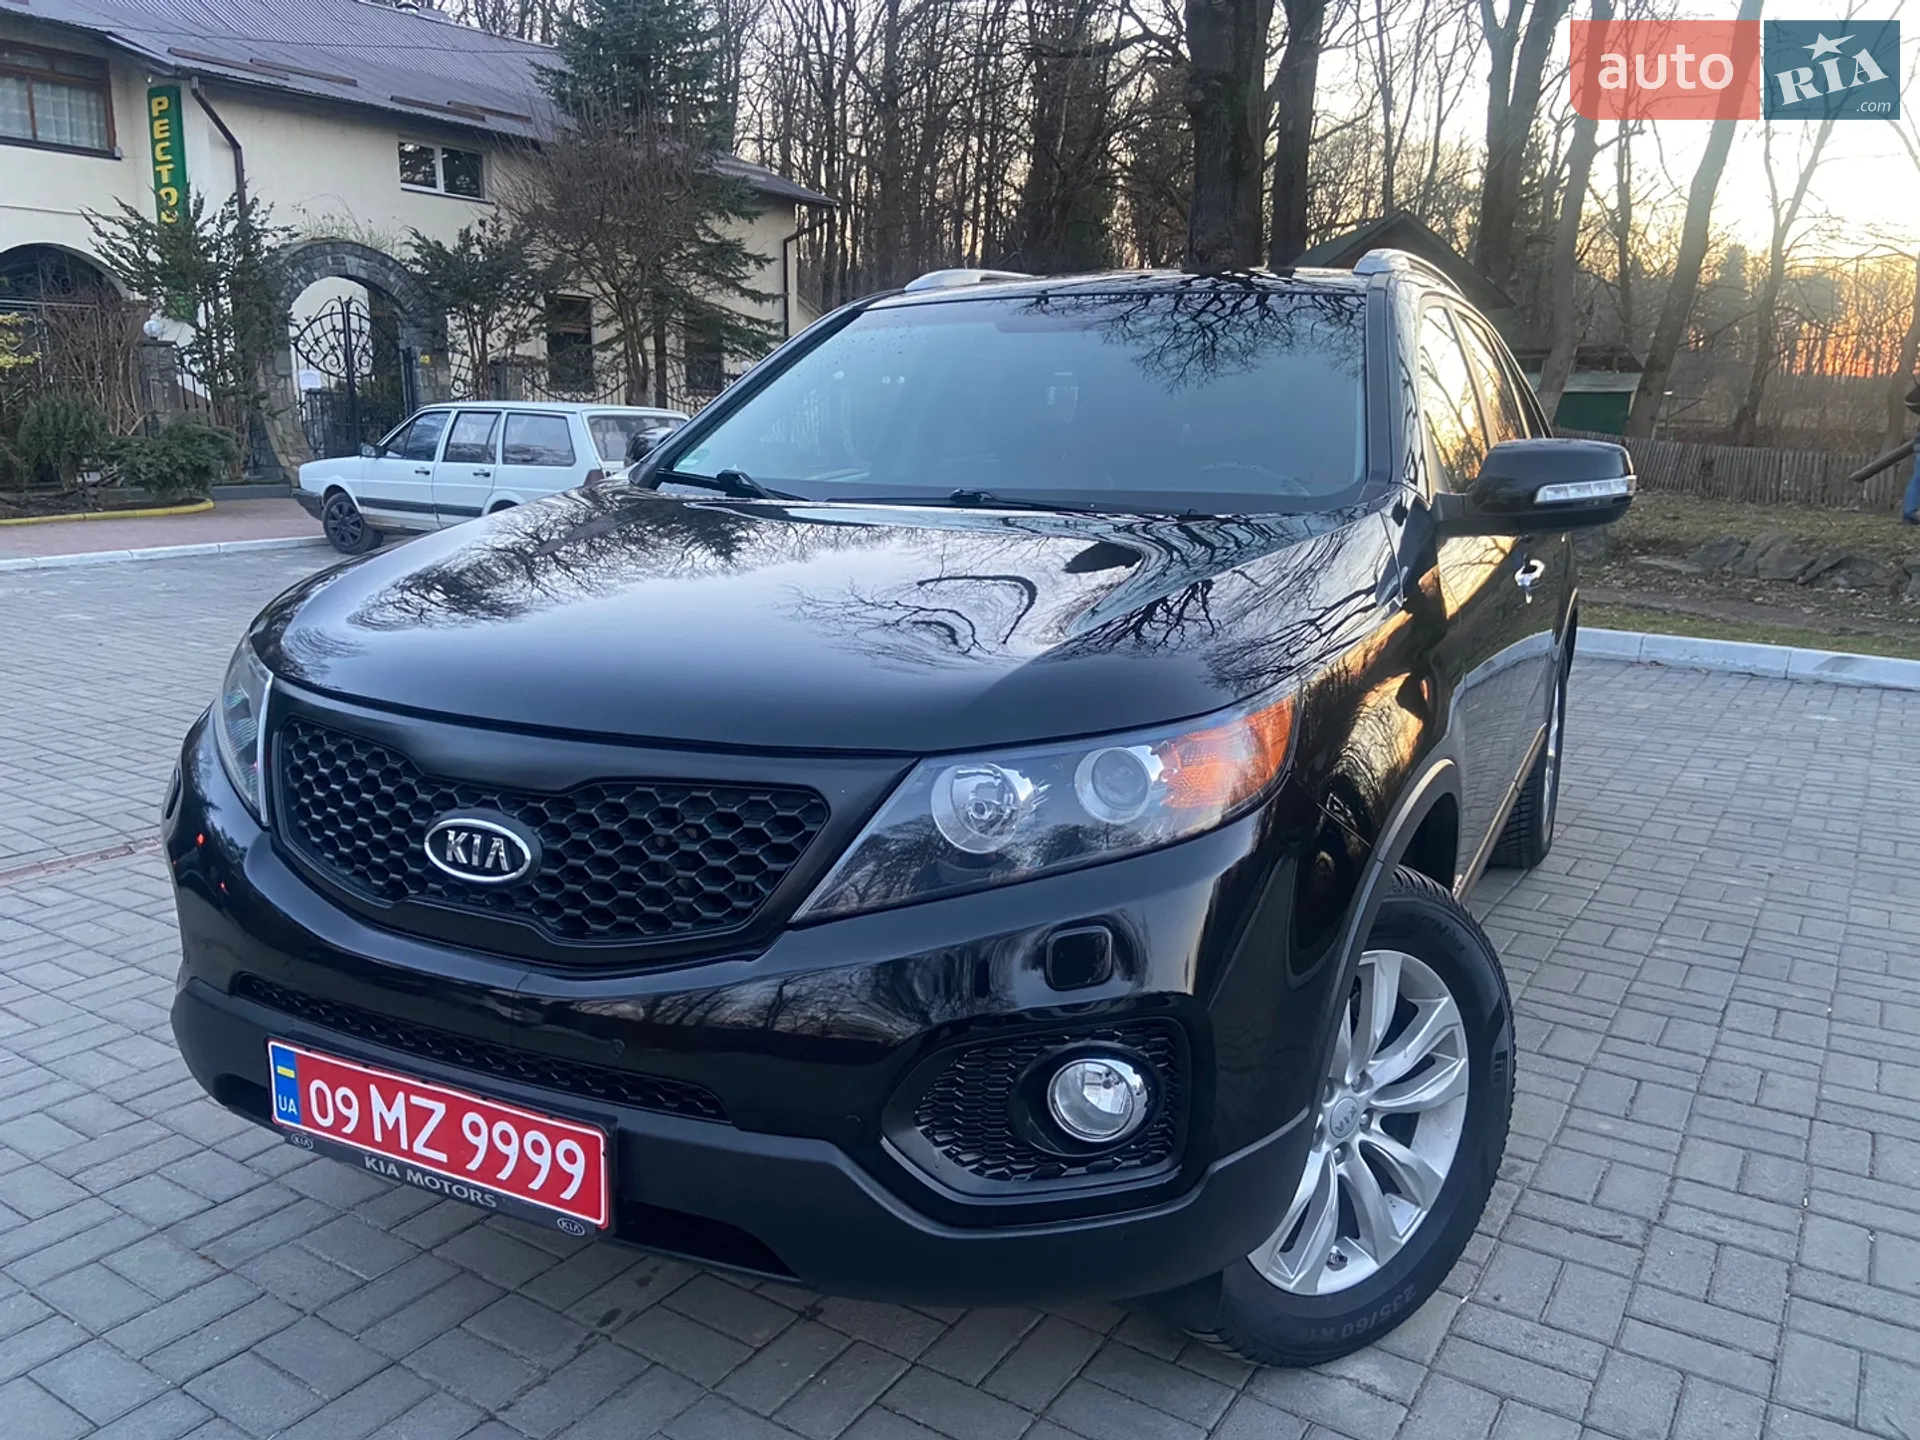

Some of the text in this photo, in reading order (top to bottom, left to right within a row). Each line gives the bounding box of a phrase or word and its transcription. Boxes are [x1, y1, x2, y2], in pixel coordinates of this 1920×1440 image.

[446, 829, 510, 871] KIA
[278, 1094, 298, 1116] UA
[293, 1135, 312, 1148] KIA
[309, 1079, 586, 1201] 09 MZ 9999
[364, 1155, 498, 1209] KIA MOTORS
[560, 1219, 582, 1233] KIA
